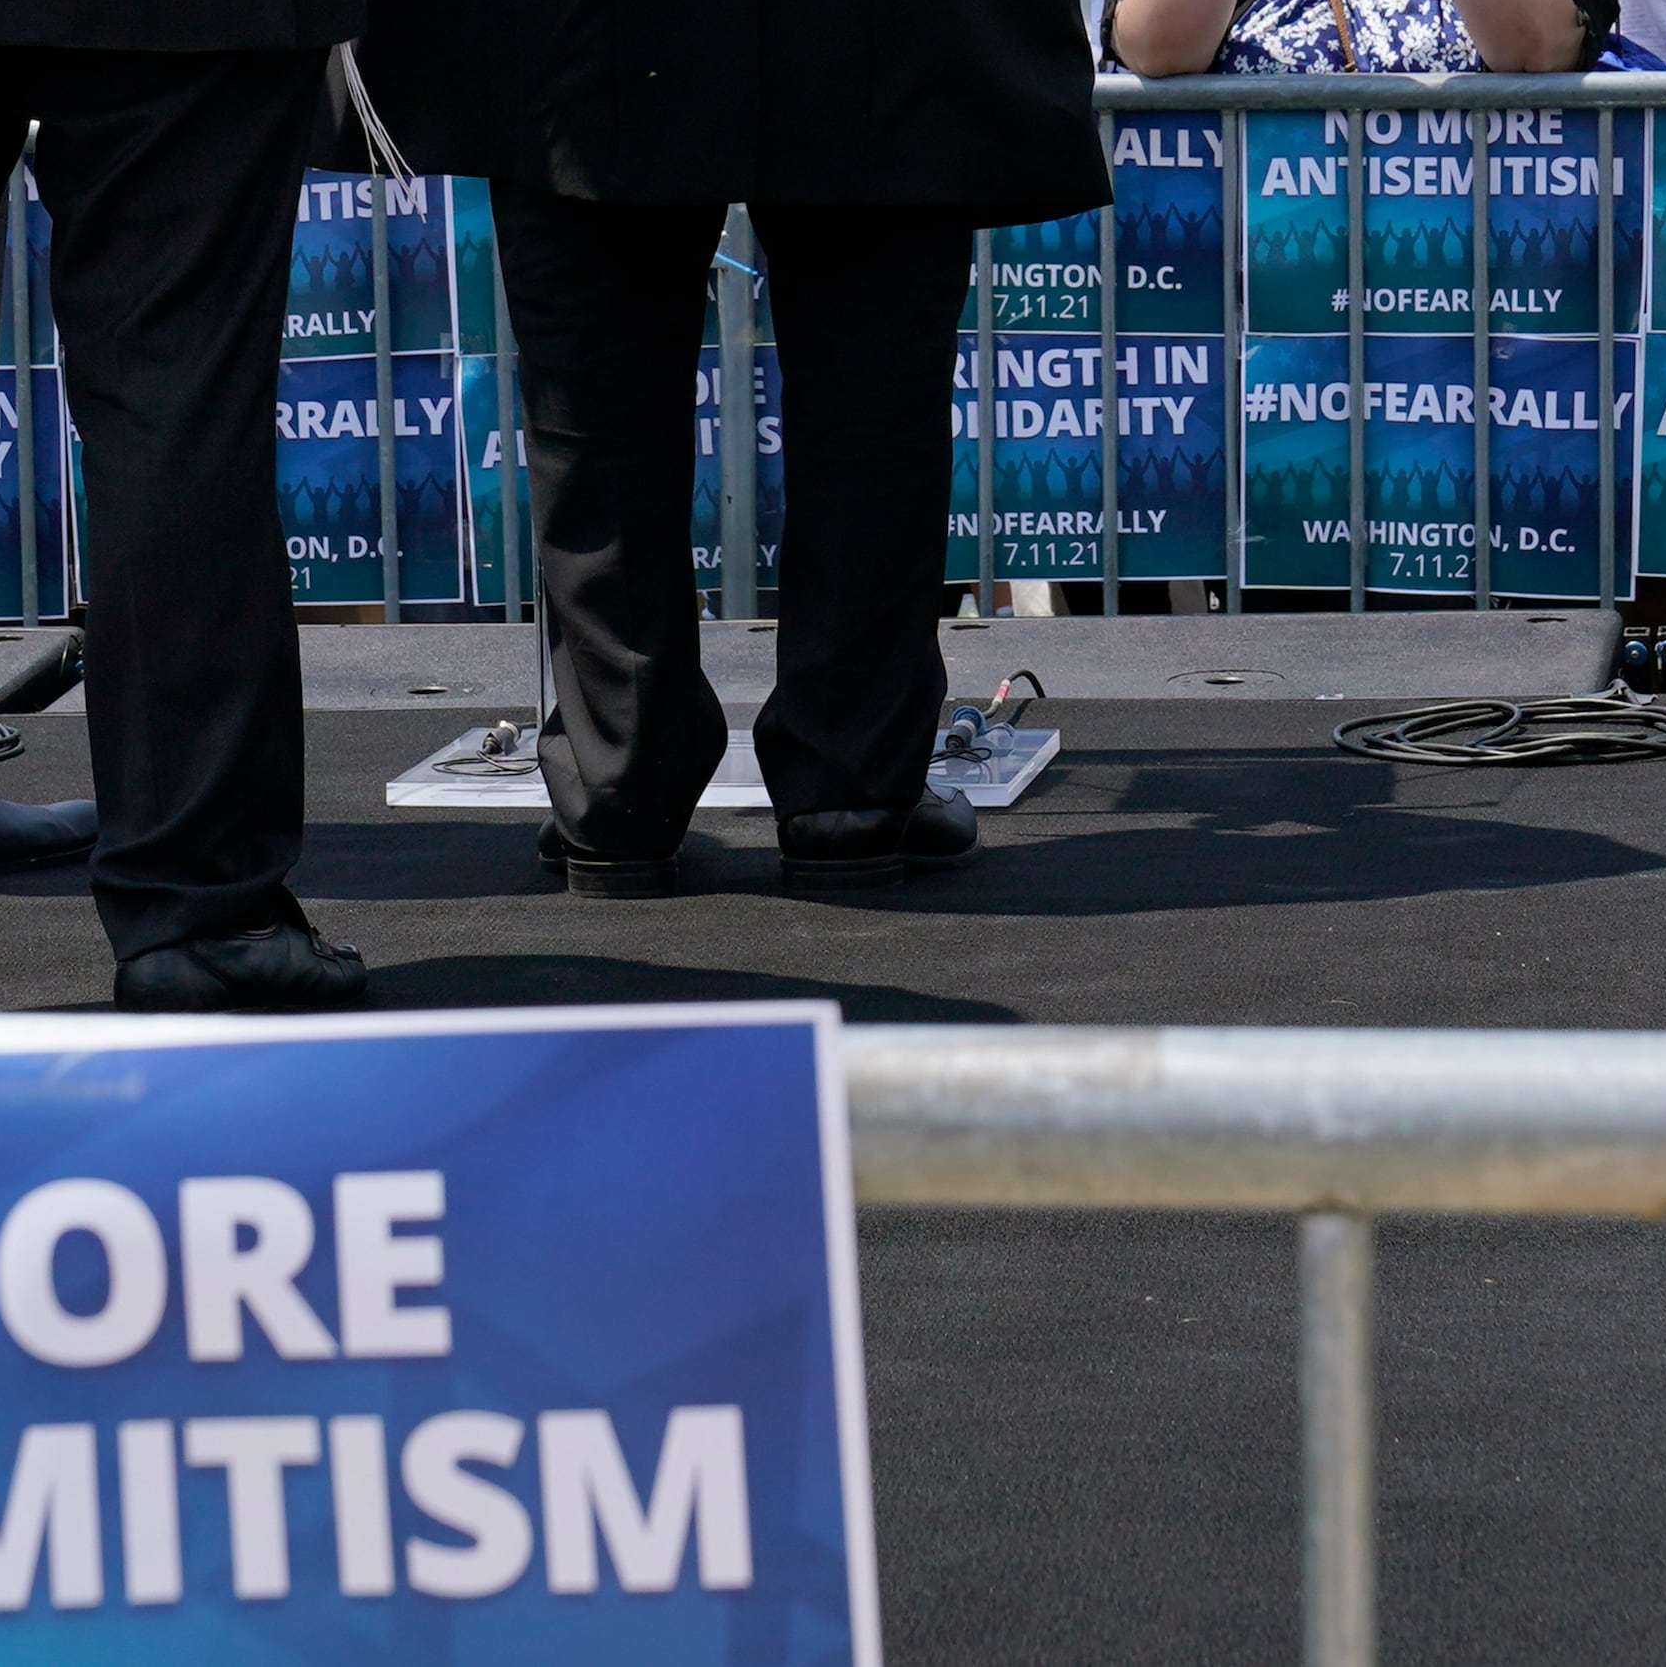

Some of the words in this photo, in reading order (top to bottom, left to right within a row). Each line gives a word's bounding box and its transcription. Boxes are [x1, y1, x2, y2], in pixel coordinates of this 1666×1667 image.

[1325, 109, 1402, 145] NO
[1127, 265, 1182, 289] D.C.
[994, 294, 1089, 319] 7.11.21
[1154, 344, 1209, 385] IN
[1519, 528, 1576, 552] D.C.
[1003, 542, 1098, 566] 7.11.21
